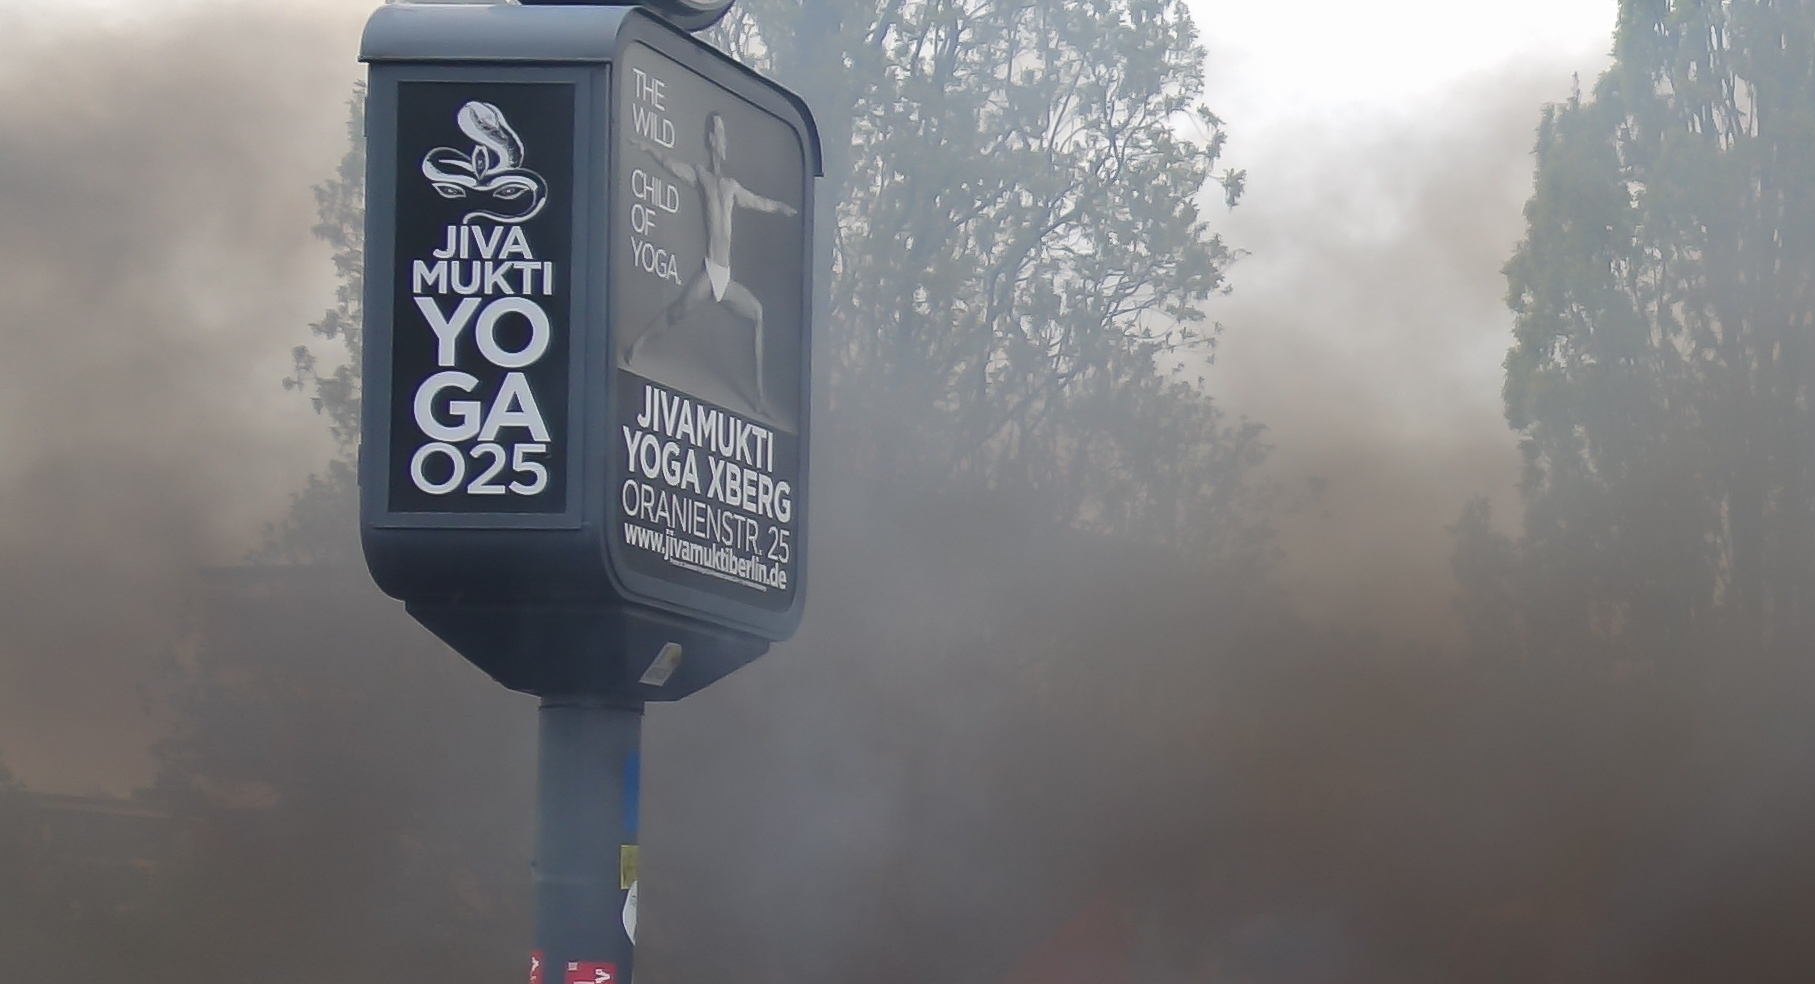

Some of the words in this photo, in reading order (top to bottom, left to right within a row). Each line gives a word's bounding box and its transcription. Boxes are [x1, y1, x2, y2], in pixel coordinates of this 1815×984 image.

[632, 67, 667, 111] THE
[632, 103, 675, 148] WILD
[631, 169, 680, 213] CHILD
[433, 225, 533, 259] JIVA
[631, 203, 657, 235] OF
[413, 259, 553, 295] MUKTI
[630, 236, 683, 285] YOGA.
[413, 296, 550, 368] YO
[413, 370, 551, 442] GA
[637, 385, 774, 473] JIVAMUKTI
[622, 425, 701, 494] YOGA
[707, 456, 791, 523] XBERG
[622, 479, 763, 556] ORANIENSTR.
[767, 526, 791, 564] 25
[624, 522, 788, 590] www.jivamuktiberlin.de
